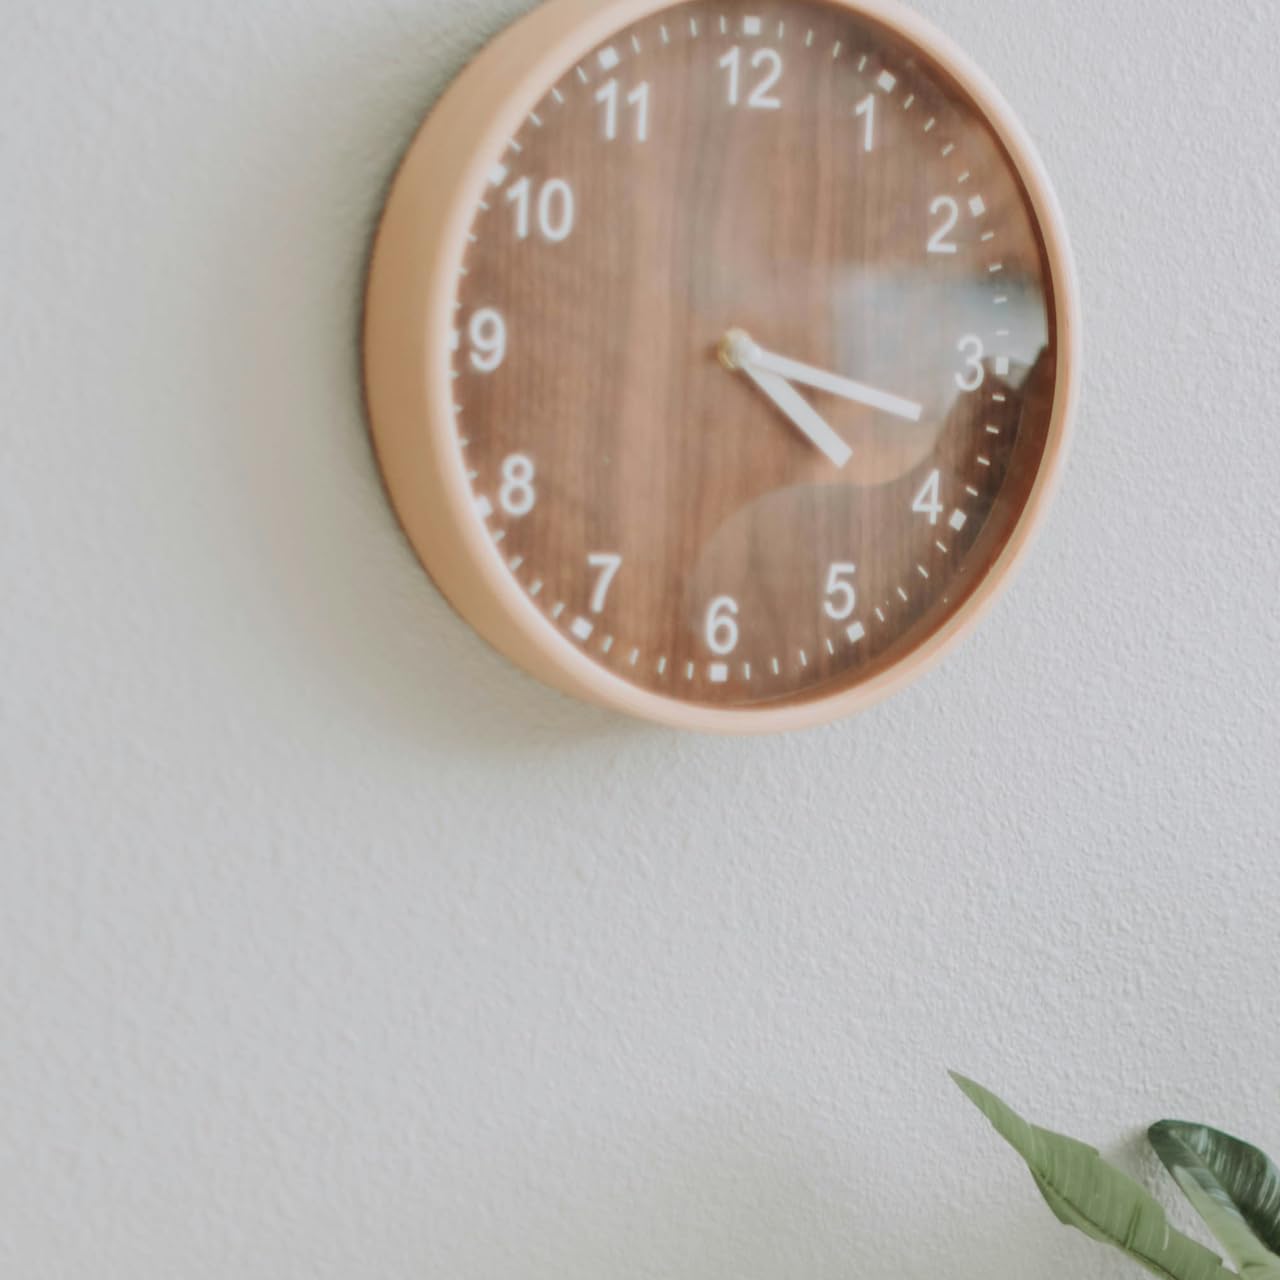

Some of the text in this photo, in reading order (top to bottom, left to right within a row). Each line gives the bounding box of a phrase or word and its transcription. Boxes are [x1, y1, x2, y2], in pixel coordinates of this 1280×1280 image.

[718, 47, 783, 108] 12
[595, 81, 651, 143] 11
[854, 95, 876, 152] 1
[505, 177, 575, 241] 10
[926, 196, 959, 253] 2
[468, 309, 506, 371] 9
[955, 335, 984, 392] 3
[500, 454, 535, 515] 8
[912, 470, 944, 524] 4
[587, 553, 622, 612] 7
[823, 563, 857, 619] 5
[704, 597, 739, 655] 6
